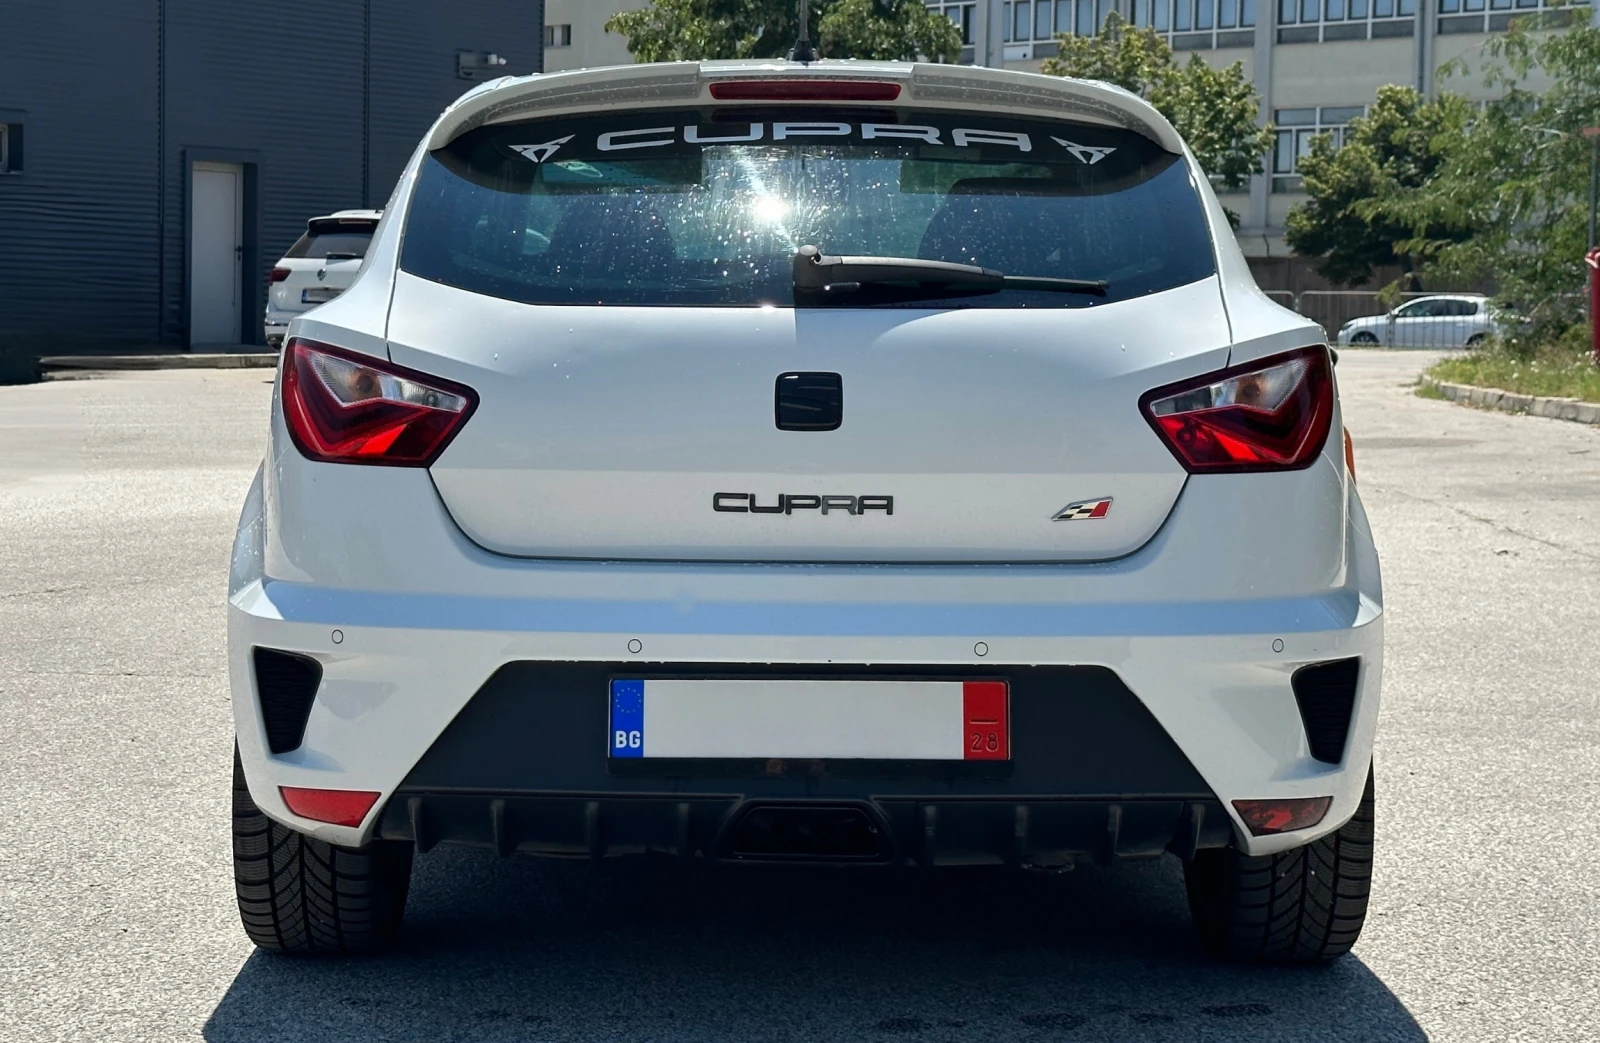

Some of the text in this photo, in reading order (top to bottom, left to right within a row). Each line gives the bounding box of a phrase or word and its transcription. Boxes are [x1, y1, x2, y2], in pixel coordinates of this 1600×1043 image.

[596, 122, 1032, 151] CUPRA
[712, 492, 894, 516] CUPRA
[615, 730, 641, 748] BG
[971, 733, 999, 752] 28
